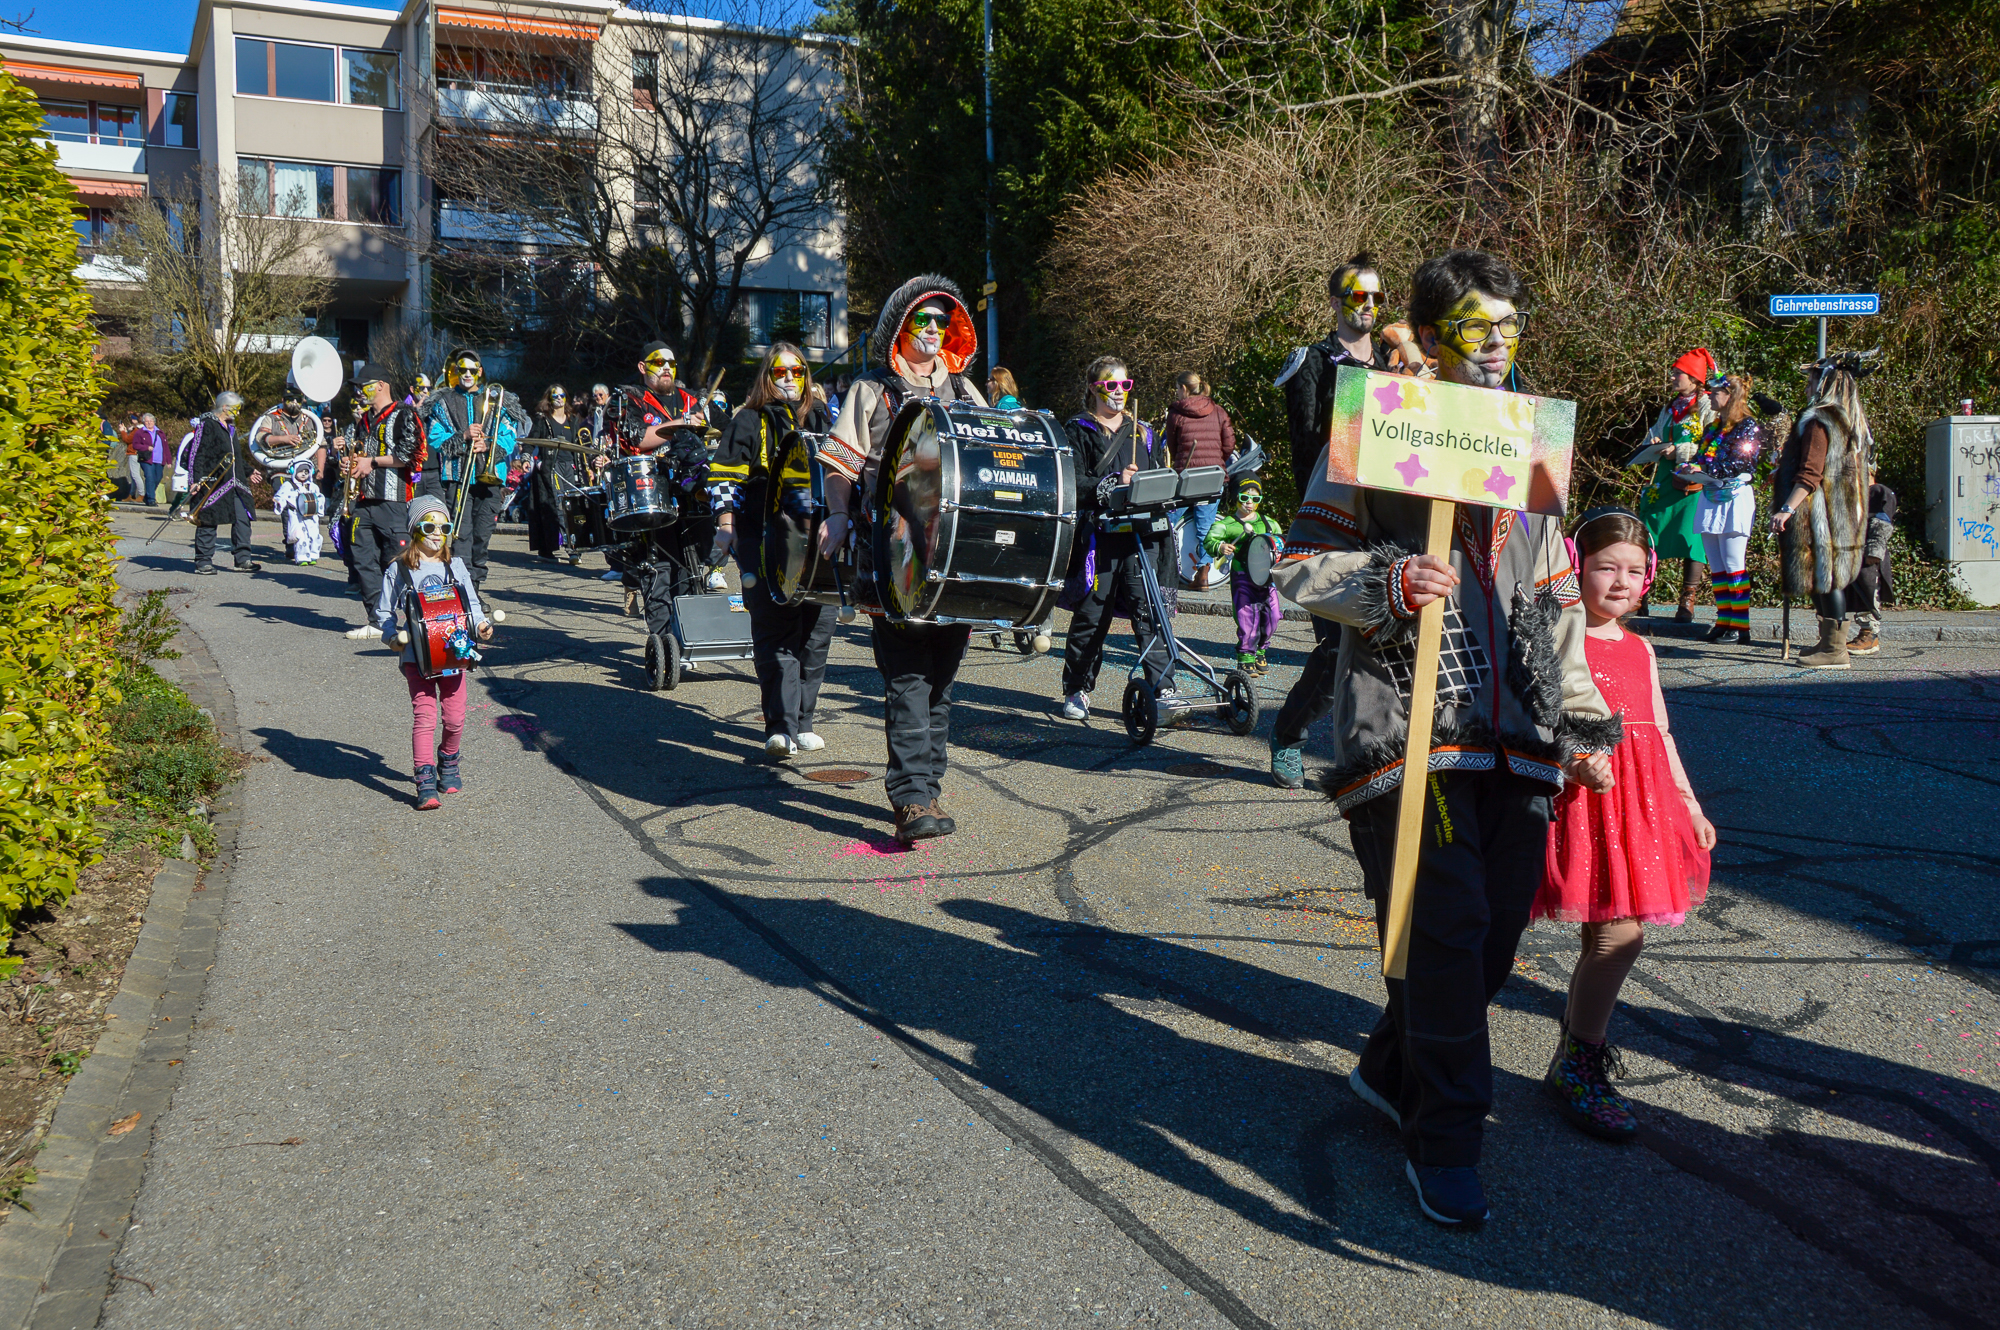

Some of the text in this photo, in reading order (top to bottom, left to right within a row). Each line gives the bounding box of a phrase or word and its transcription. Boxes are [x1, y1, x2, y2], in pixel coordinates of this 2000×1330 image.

[1775, 298, 1874, 312] Gehrrebenstrasse
[993, 451, 1024, 461] LEIDER
[999, 459, 1020, 468] GEIL
[992, 470, 1038, 487] YAMAHA
[1427, 770, 1454, 843] gashöckler
